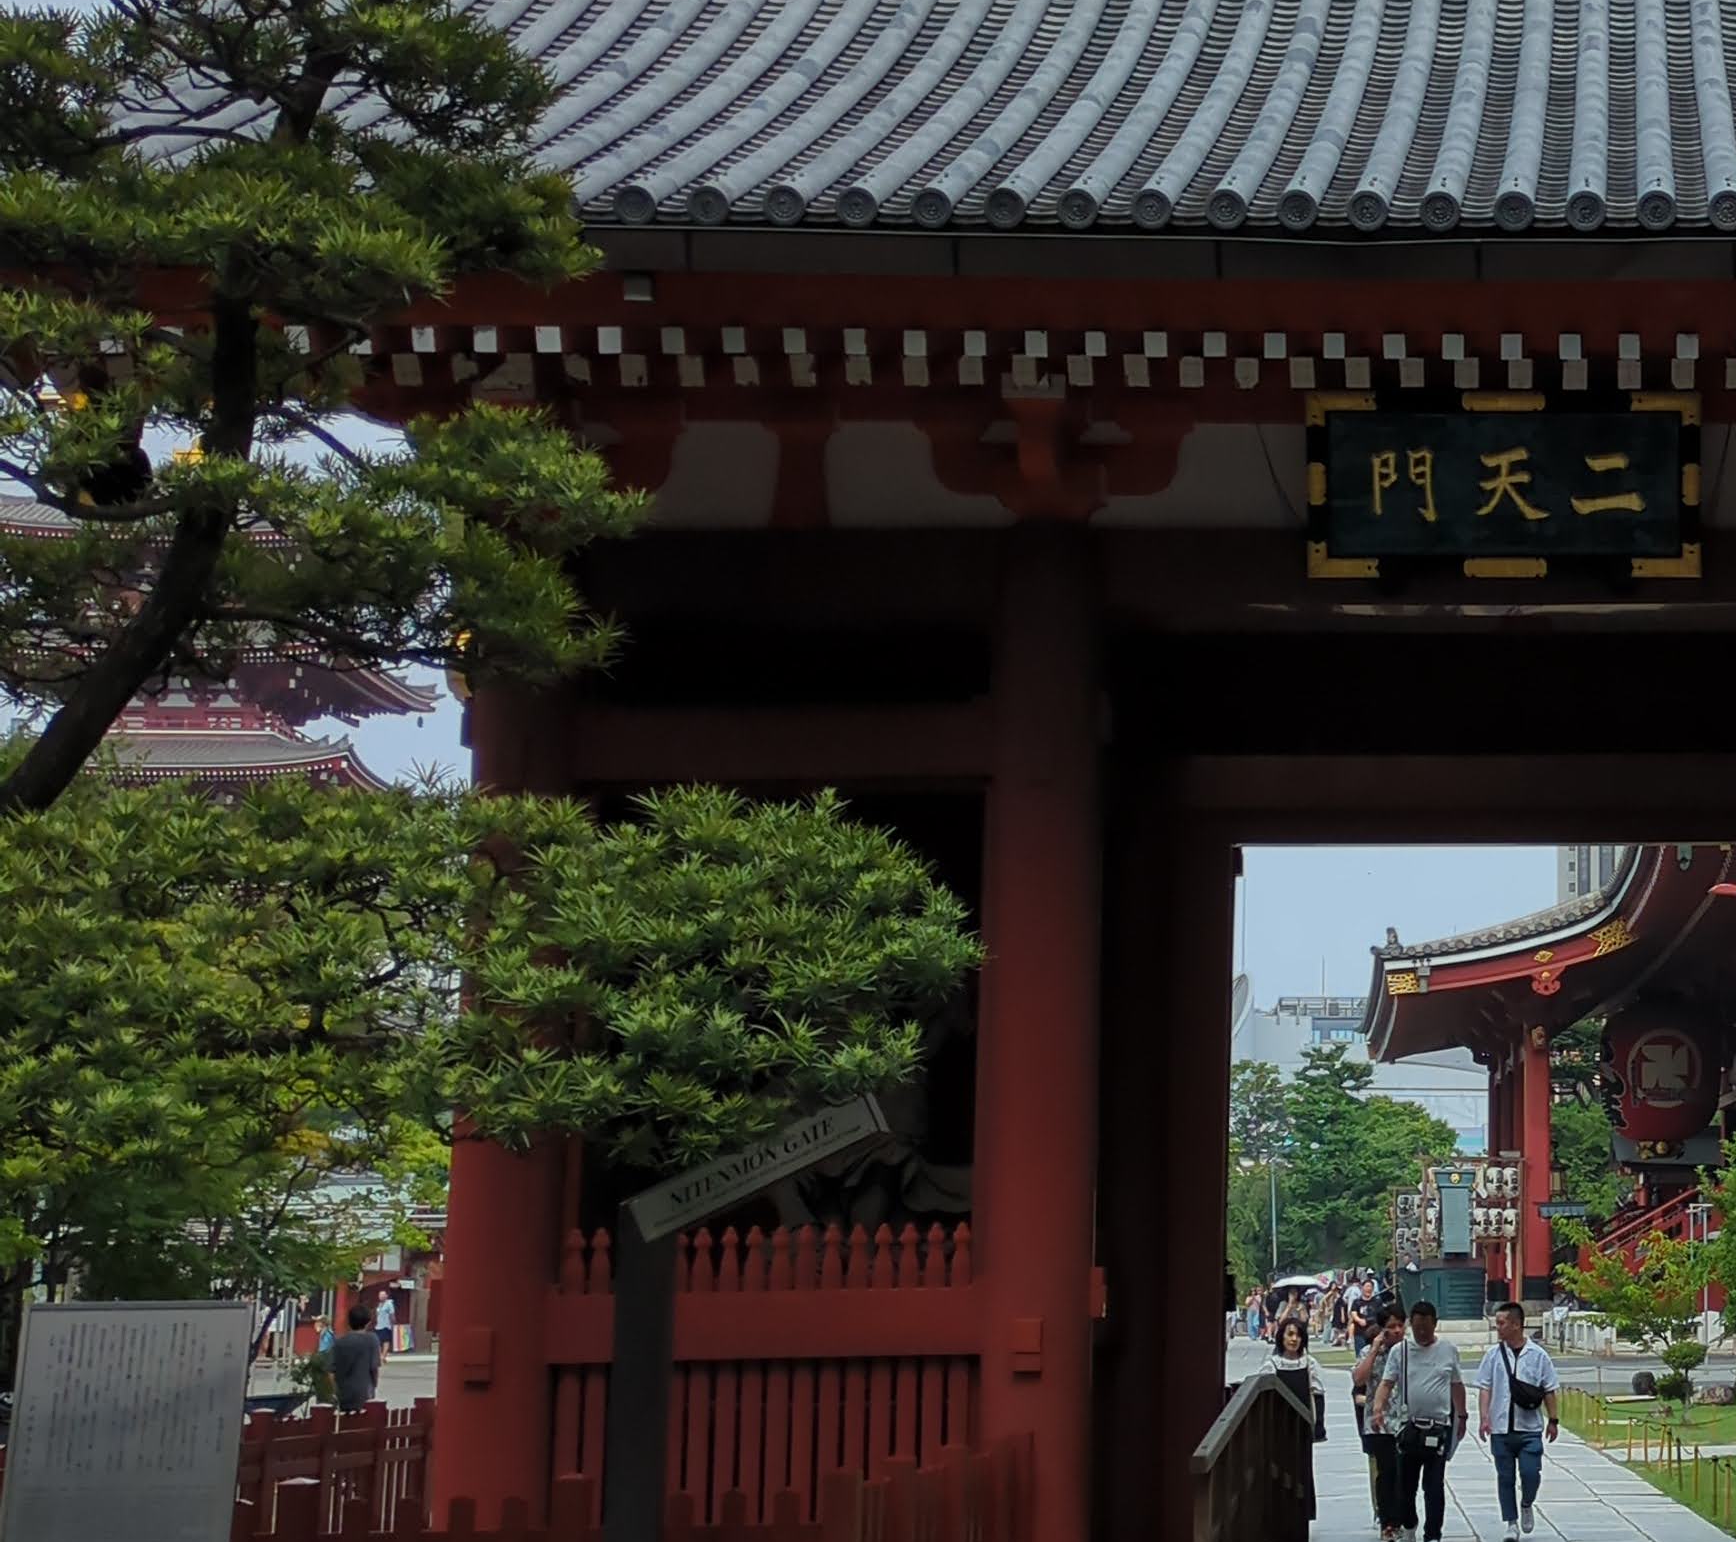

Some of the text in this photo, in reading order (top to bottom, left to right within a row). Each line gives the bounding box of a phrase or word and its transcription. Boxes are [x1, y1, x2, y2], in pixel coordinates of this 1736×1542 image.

[1371, 445, 1646, 522] 二天門
[783, 1117, 834, 1153] GATE
